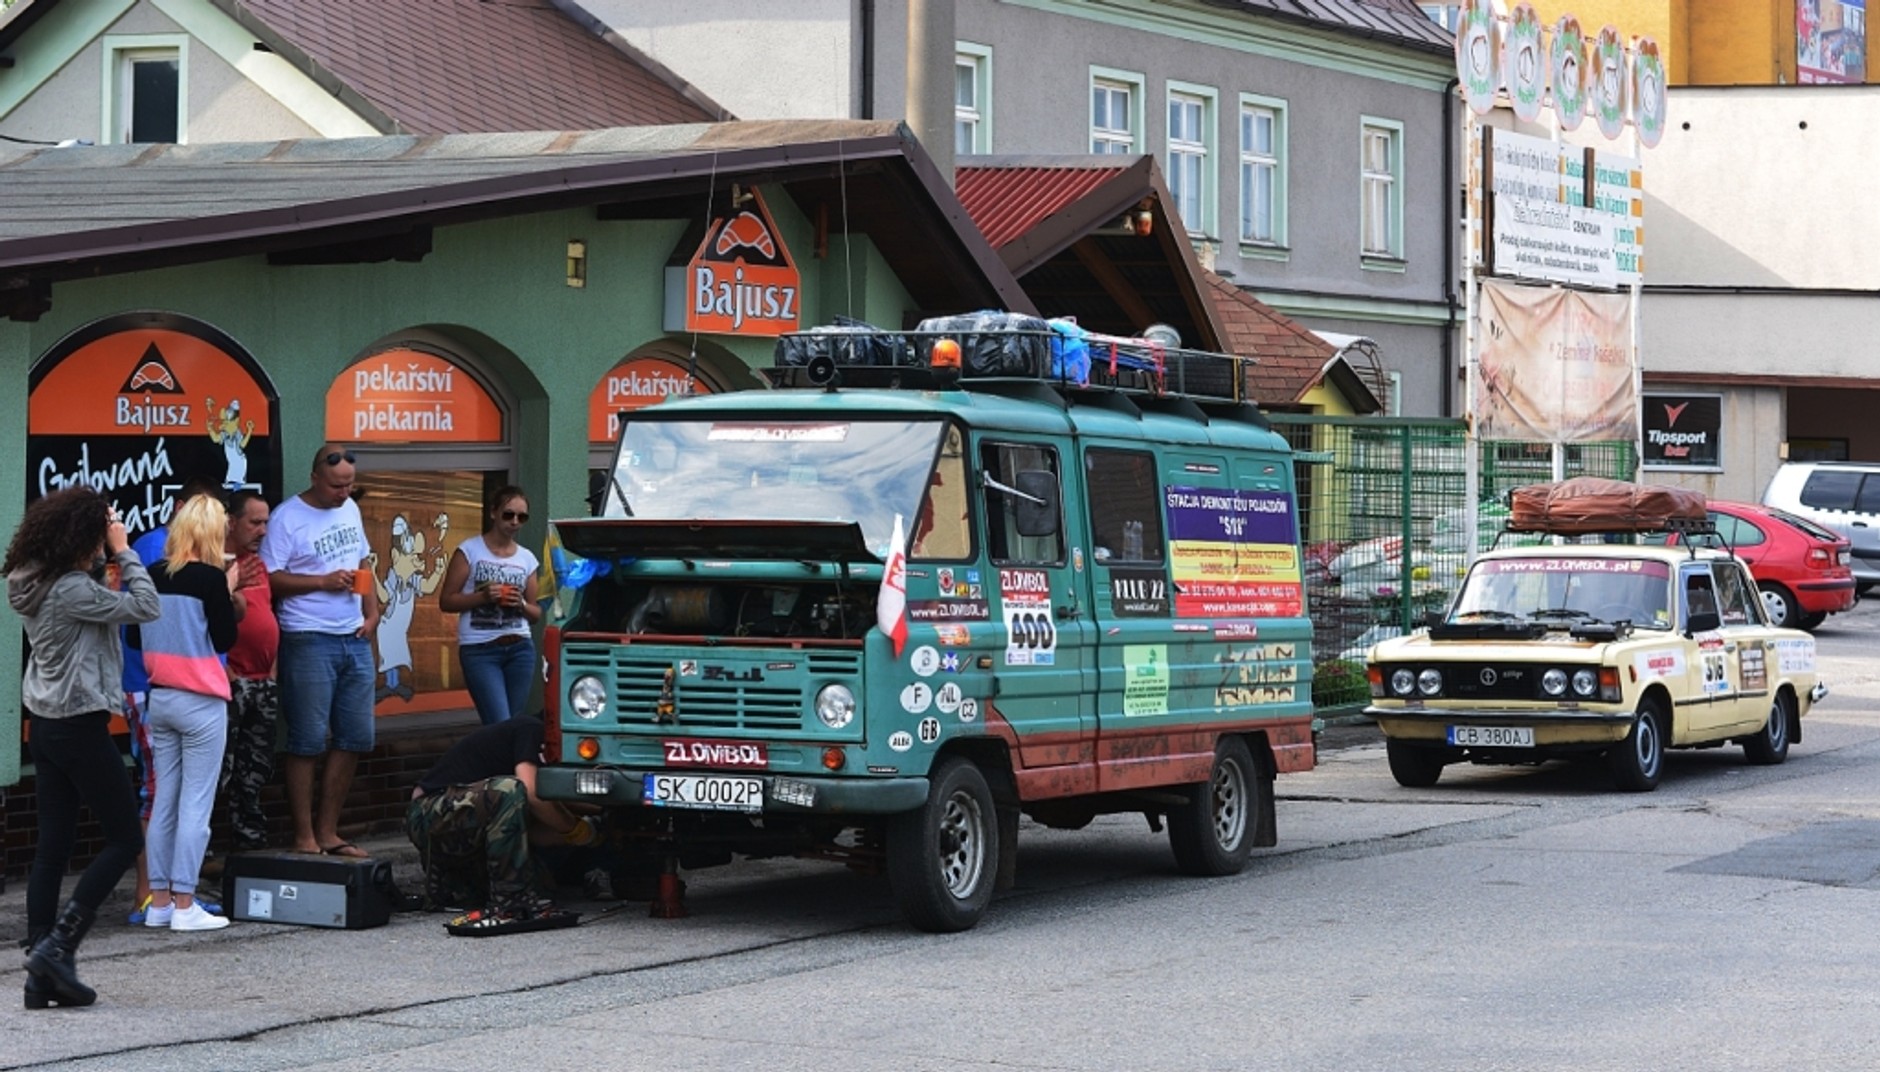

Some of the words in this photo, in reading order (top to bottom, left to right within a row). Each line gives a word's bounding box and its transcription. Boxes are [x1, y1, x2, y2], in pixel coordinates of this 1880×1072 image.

[695, 266, 796, 329] Bajusz
[354, 363, 454, 399] pekařství
[607, 370, 690, 404] pekařství
[116, 396, 191, 433] Bajusz
[354, 402, 454, 438] piekarnia
[1648, 429, 1706, 446] Tipsport
[1167, 493, 1199, 508] STACJA
[1000, 570, 1050, 592] ZLOMBOL
[1150, 579, 1166, 600] 22
[1011, 613, 1054, 649] 400
[913, 686, 922, 704] F
[940, 686, 956, 704] NL
[962, 702, 974, 717] CZ
[921, 719, 938, 741] GB
[1456, 728, 1479, 744] CB
[1484, 728, 1531, 745] 380AJ
[664, 742, 767, 765] ZLOMBOL
[657, 778, 688, 802] SK
[694, 779, 761, 804] 0002P
